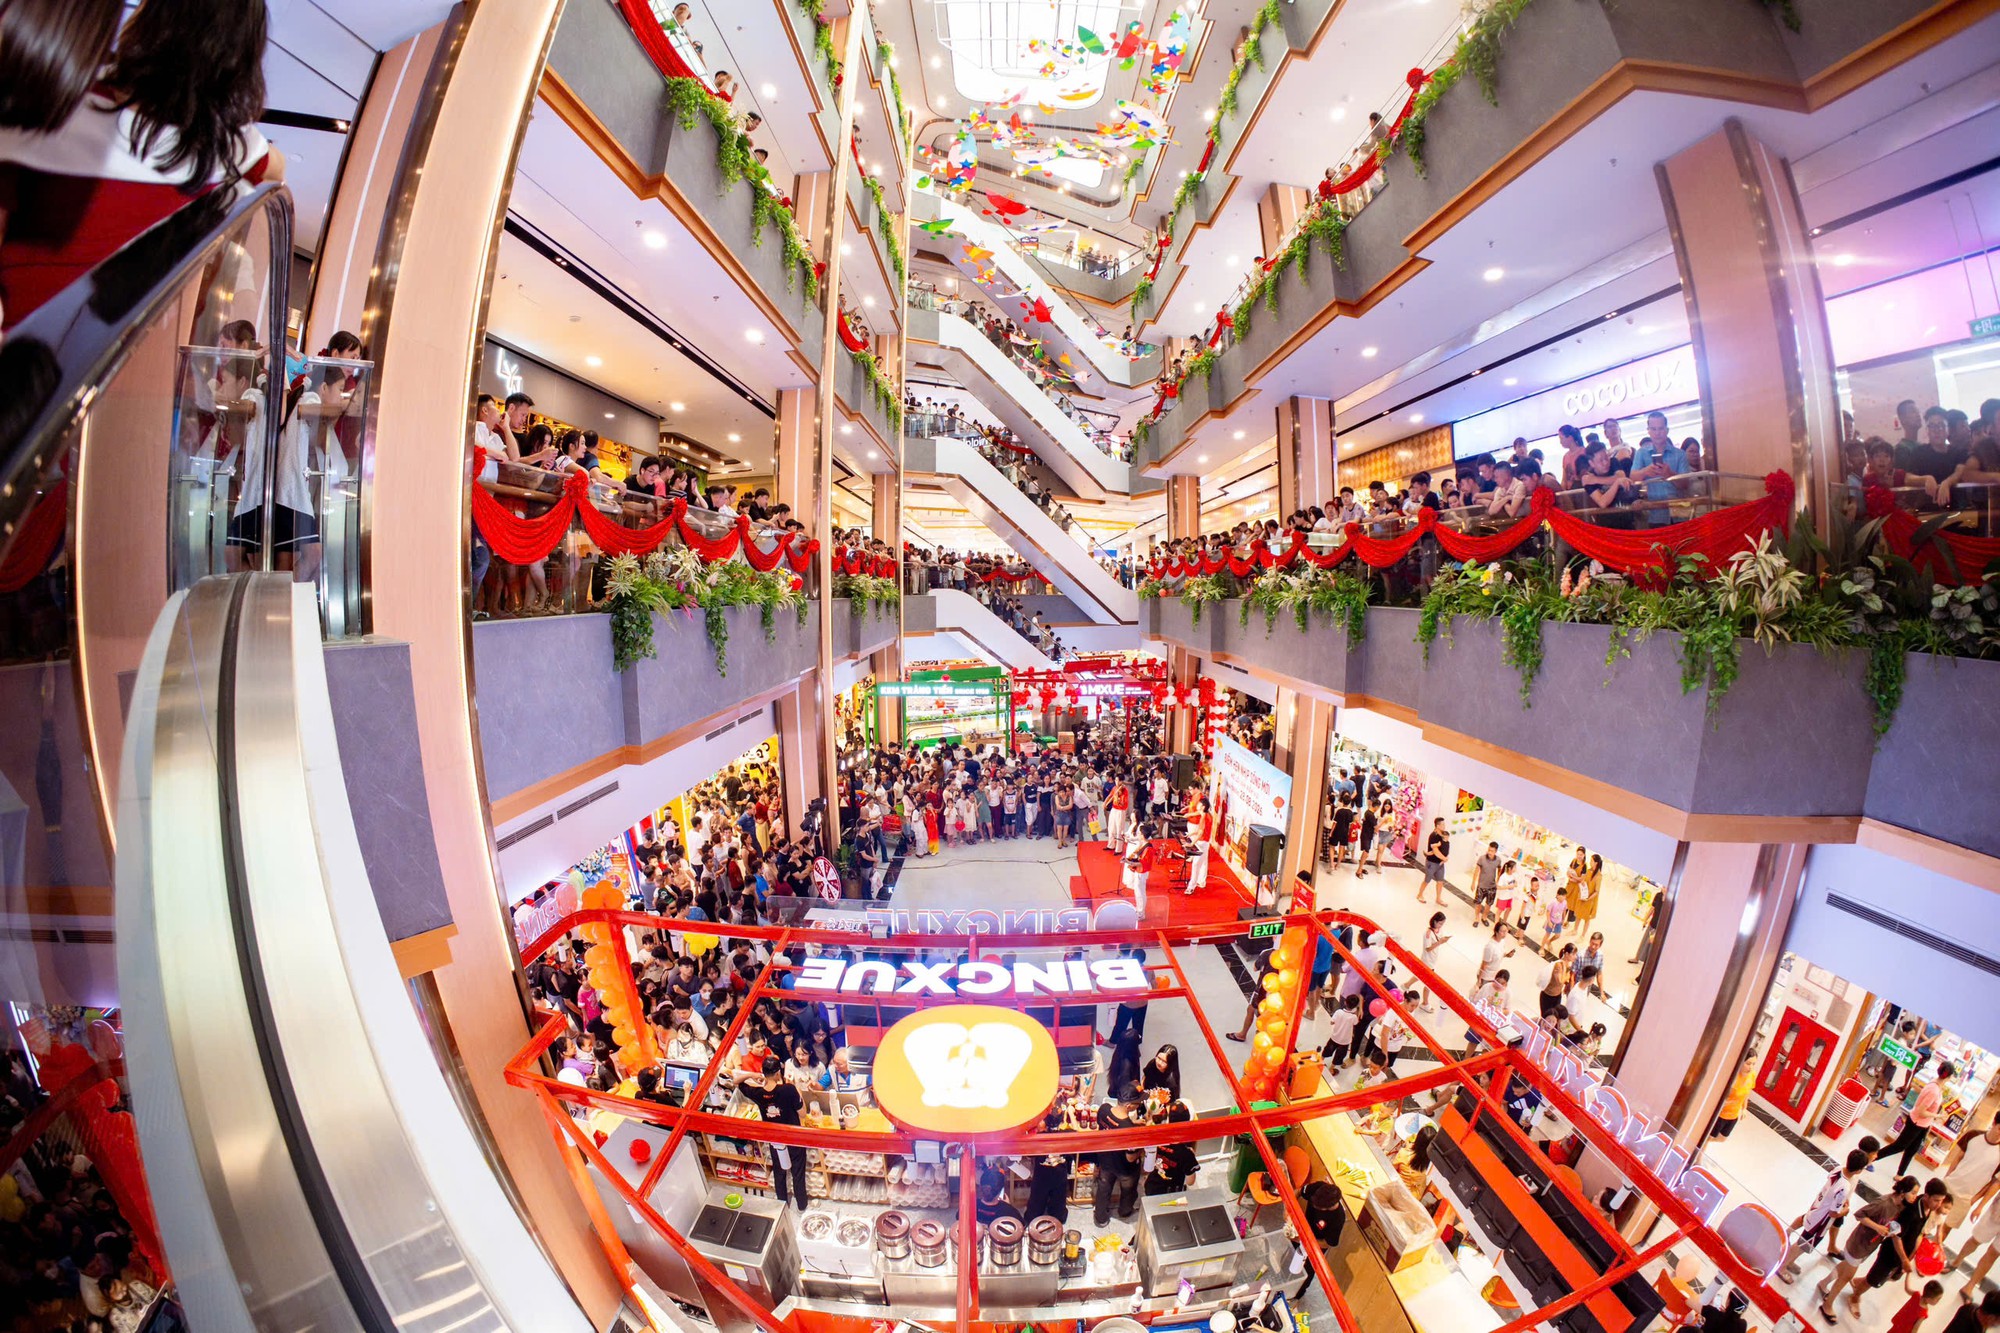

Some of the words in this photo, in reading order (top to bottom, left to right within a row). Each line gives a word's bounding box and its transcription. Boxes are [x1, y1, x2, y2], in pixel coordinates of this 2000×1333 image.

[1563, 361, 1681, 416] COCOLUX
[1088, 684, 1125, 695] MIXUE
[1253, 923, 1282, 937] EXIT
[794, 957, 1148, 996] BINGXUE
